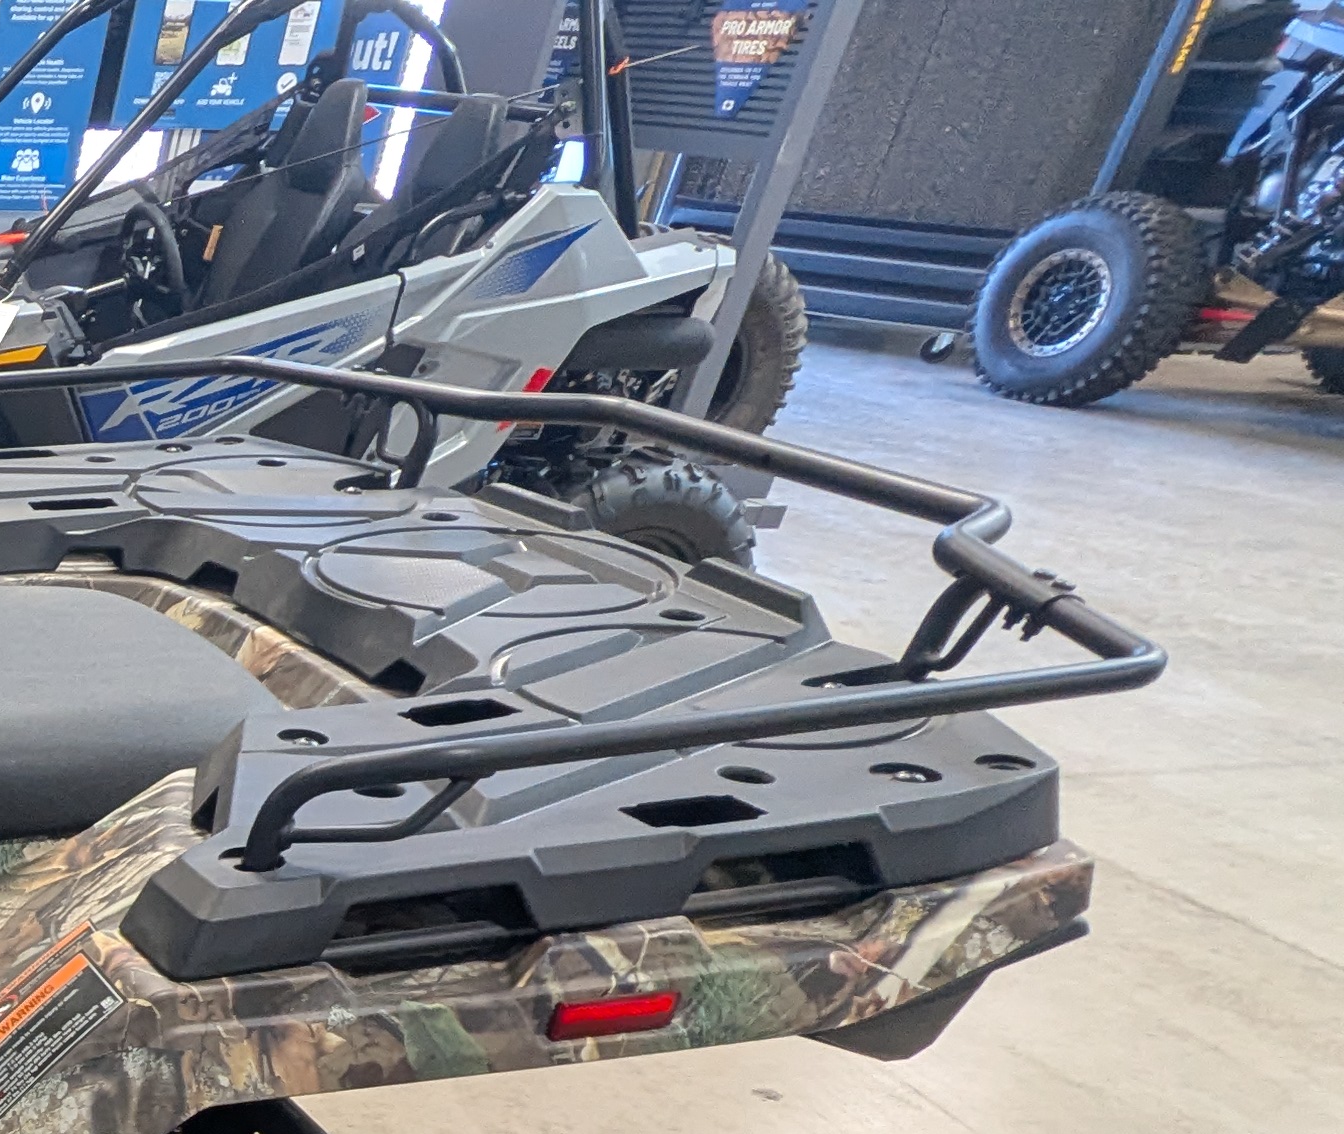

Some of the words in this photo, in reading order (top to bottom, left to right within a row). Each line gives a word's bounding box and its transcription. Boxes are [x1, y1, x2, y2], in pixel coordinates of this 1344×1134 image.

[720, 20, 746, 35] PRO
[745, 18, 794, 35] ARMOR
[351, 31, 400, 71] ut!
[732, 40, 768, 55] TIRES
[157, 396, 233, 432] 200
